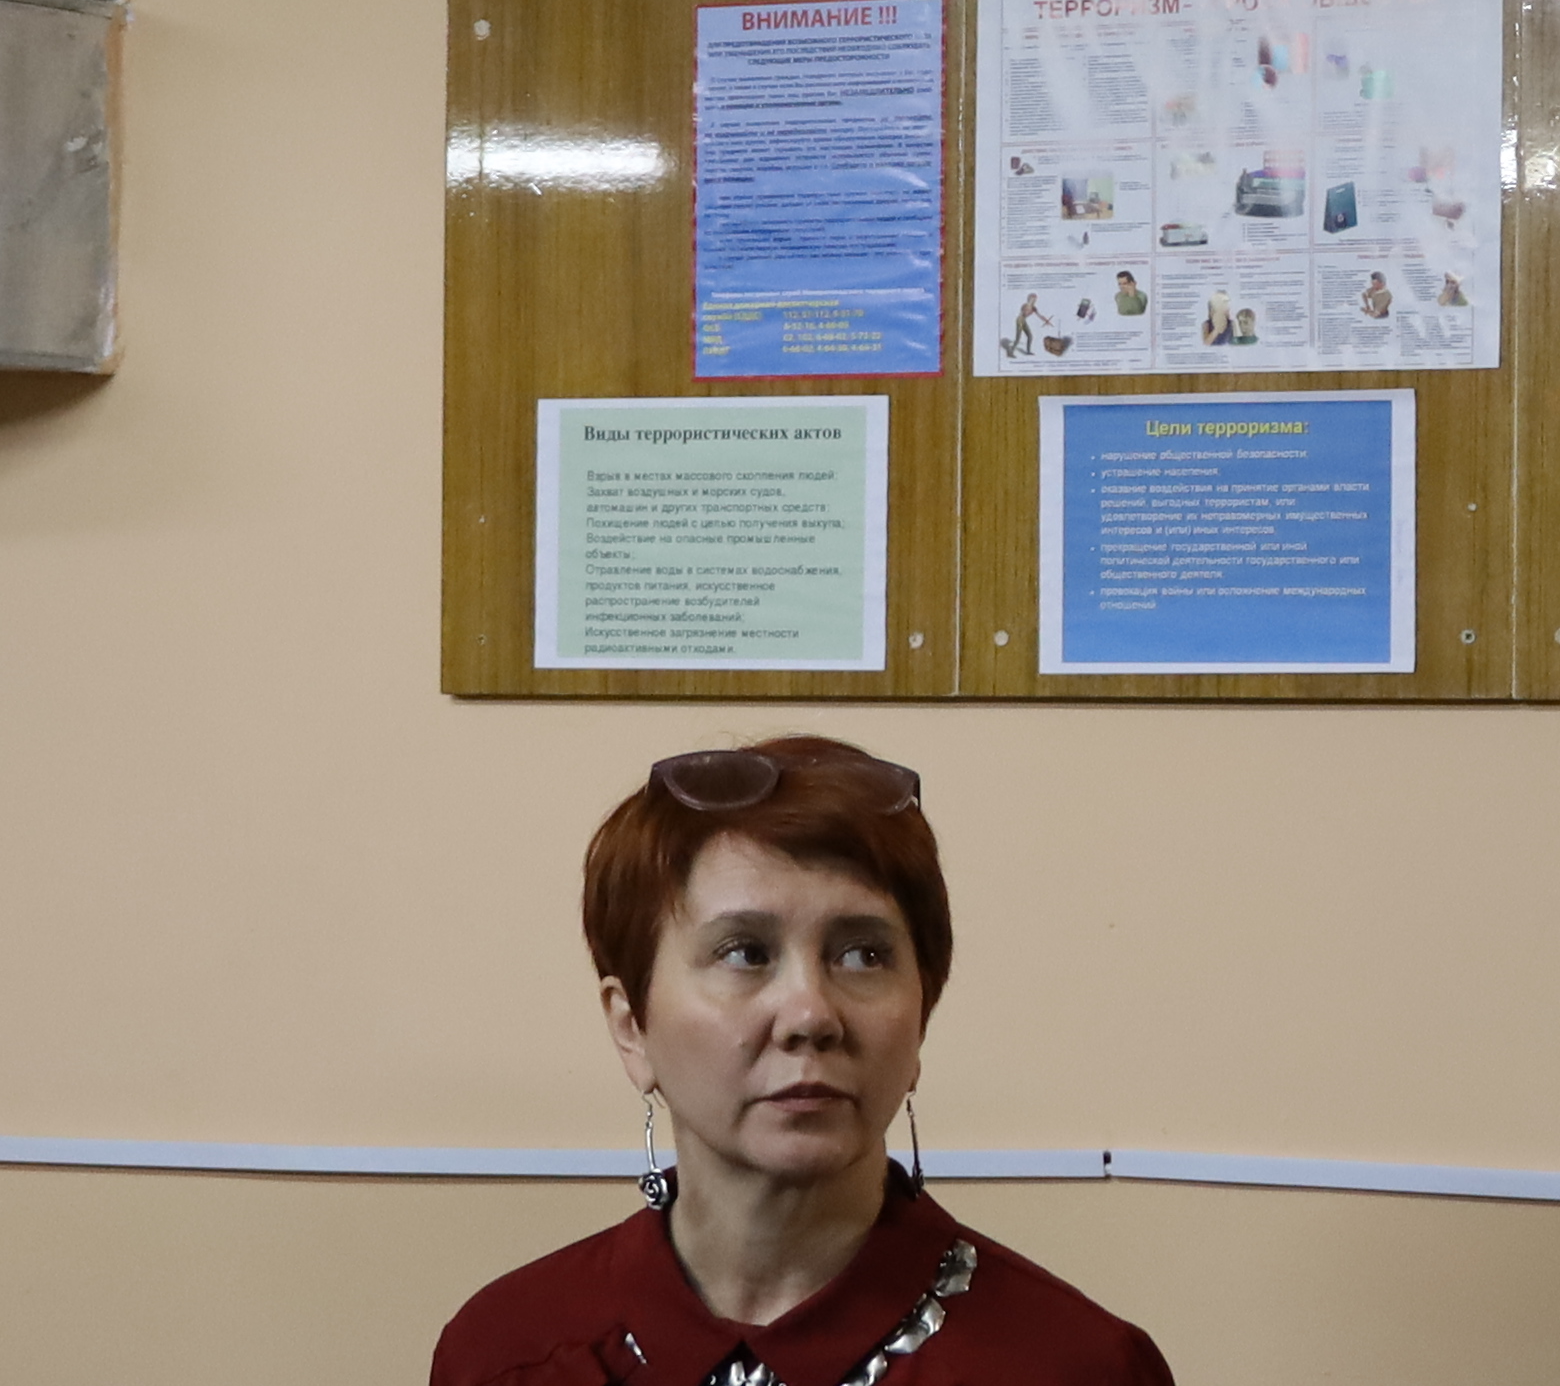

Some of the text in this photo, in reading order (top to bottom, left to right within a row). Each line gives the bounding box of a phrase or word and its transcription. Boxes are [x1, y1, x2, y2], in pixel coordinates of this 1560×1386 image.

[742, 6, 897, 30] ВНИМАНИЕ !!!
[584, 426, 842, 444] Виды террористических актов
[1146, 421, 1310, 437] Цели терроризма:
[1100, 451, 1157, 461] нарушение
[1160, 449, 1233, 461] общественной
[634, 472, 672, 481] местах
[676, 472, 732, 481] массового
[736, 472, 794, 482] скопления
[1101, 467, 1162, 478] устрашение
[587, 487, 623, 496] Захват
[628, 488, 688, 499] воздушных
[702, 488, 746, 499] морских
[1101, 483, 1147, 493] оказание
[1149, 483, 1213, 493] воздействия
[1231, 483, 1278, 493] принятие
[1282, 483, 1330, 493] органами
[1334, 483, 1370, 491] власти
[586, 504, 648, 513] автомашин
[652, 504, 658, 512] и
[662, 504, 698, 515] других
[701, 503, 779, 514] транспортных
[1152, 498, 1200, 508] выгодных
[1275, 498, 1296, 507] или
[1100, 511, 1368, 523] удовлетворение их неправомерных имущественных
[586, 518, 649, 530] Похищение
[653, 518, 689, 530] людей
[692, 519, 697, 528] с
[701, 519, 735, 530] целью
[739, 519, 798, 530] получения
[1100, 526, 1153, 535] интересов
[1156, 526, 1162, 534] и
[1165, 525, 1192, 537] (или)
[1193, 525, 1219, 534] иных
[586, 534, 816, 545] Воздействие на опасные промышленные
[1100, 541, 1307, 553] прекращение государственной или иной
[1100, 555, 1360, 567] политической деятельности государственного или
[585, 565, 652, 576] Отравление
[656, 566, 684, 576] воды
[687, 566, 693, 574] в
[696, 566, 748, 575] системах
[1100, 569, 1177, 581] общественного
[585, 581, 641, 593] продуктов
[695, 582, 776, 593] искусственное
[1100, 586, 1367, 597] провокация войны или осложнение международных
[585, 595, 760, 609] распространение возбудителей
[585, 612, 667, 624] инфекционных
[585, 627, 800, 640] Искусственное загрязнение местности
[584, 643, 678, 655] радиоактивными
